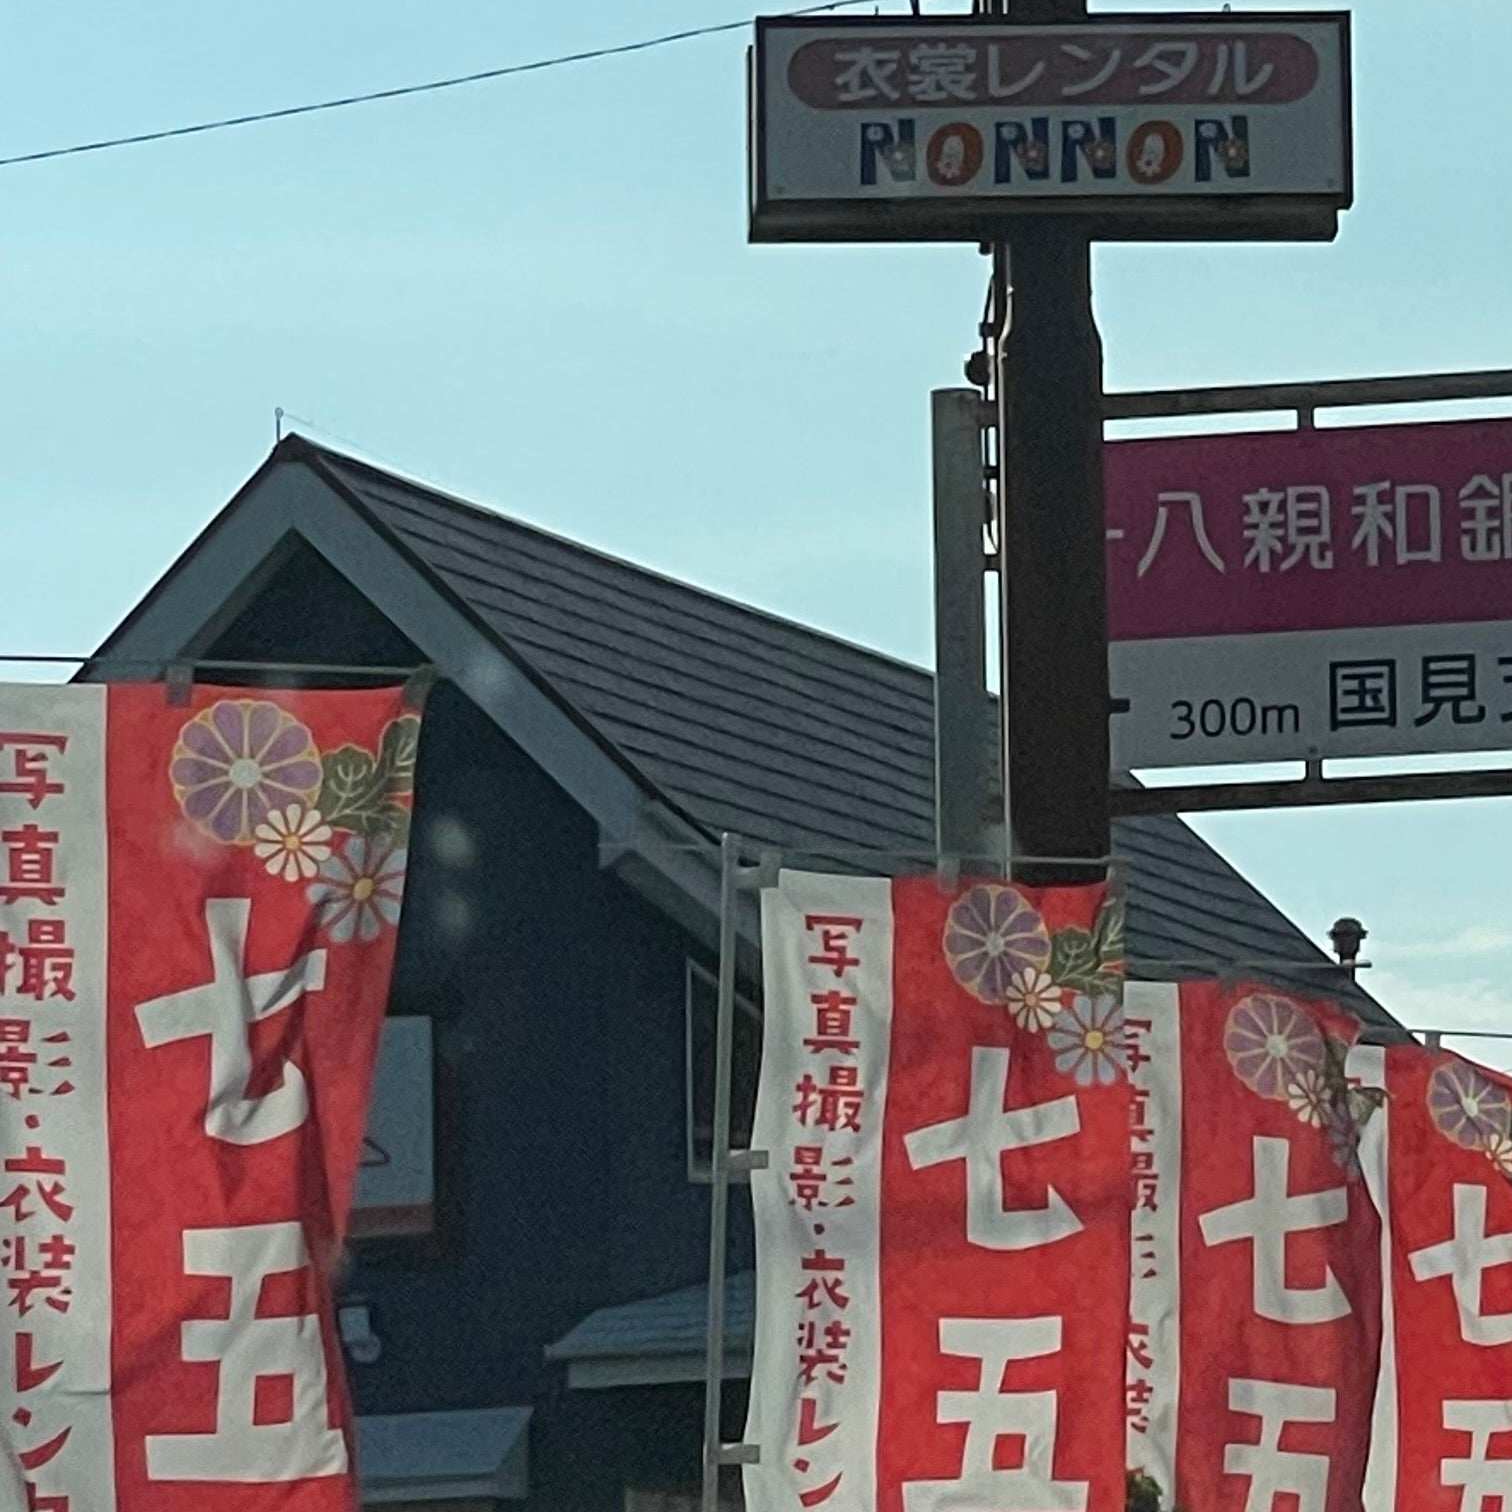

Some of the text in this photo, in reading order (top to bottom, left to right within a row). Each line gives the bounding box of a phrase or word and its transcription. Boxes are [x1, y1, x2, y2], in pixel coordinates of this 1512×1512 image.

[833, 40, 1276, 102] 衣裳レンタル
[859, 115, 1251, 187] NONNON
[1169, 697, 1301, 741] 300m
